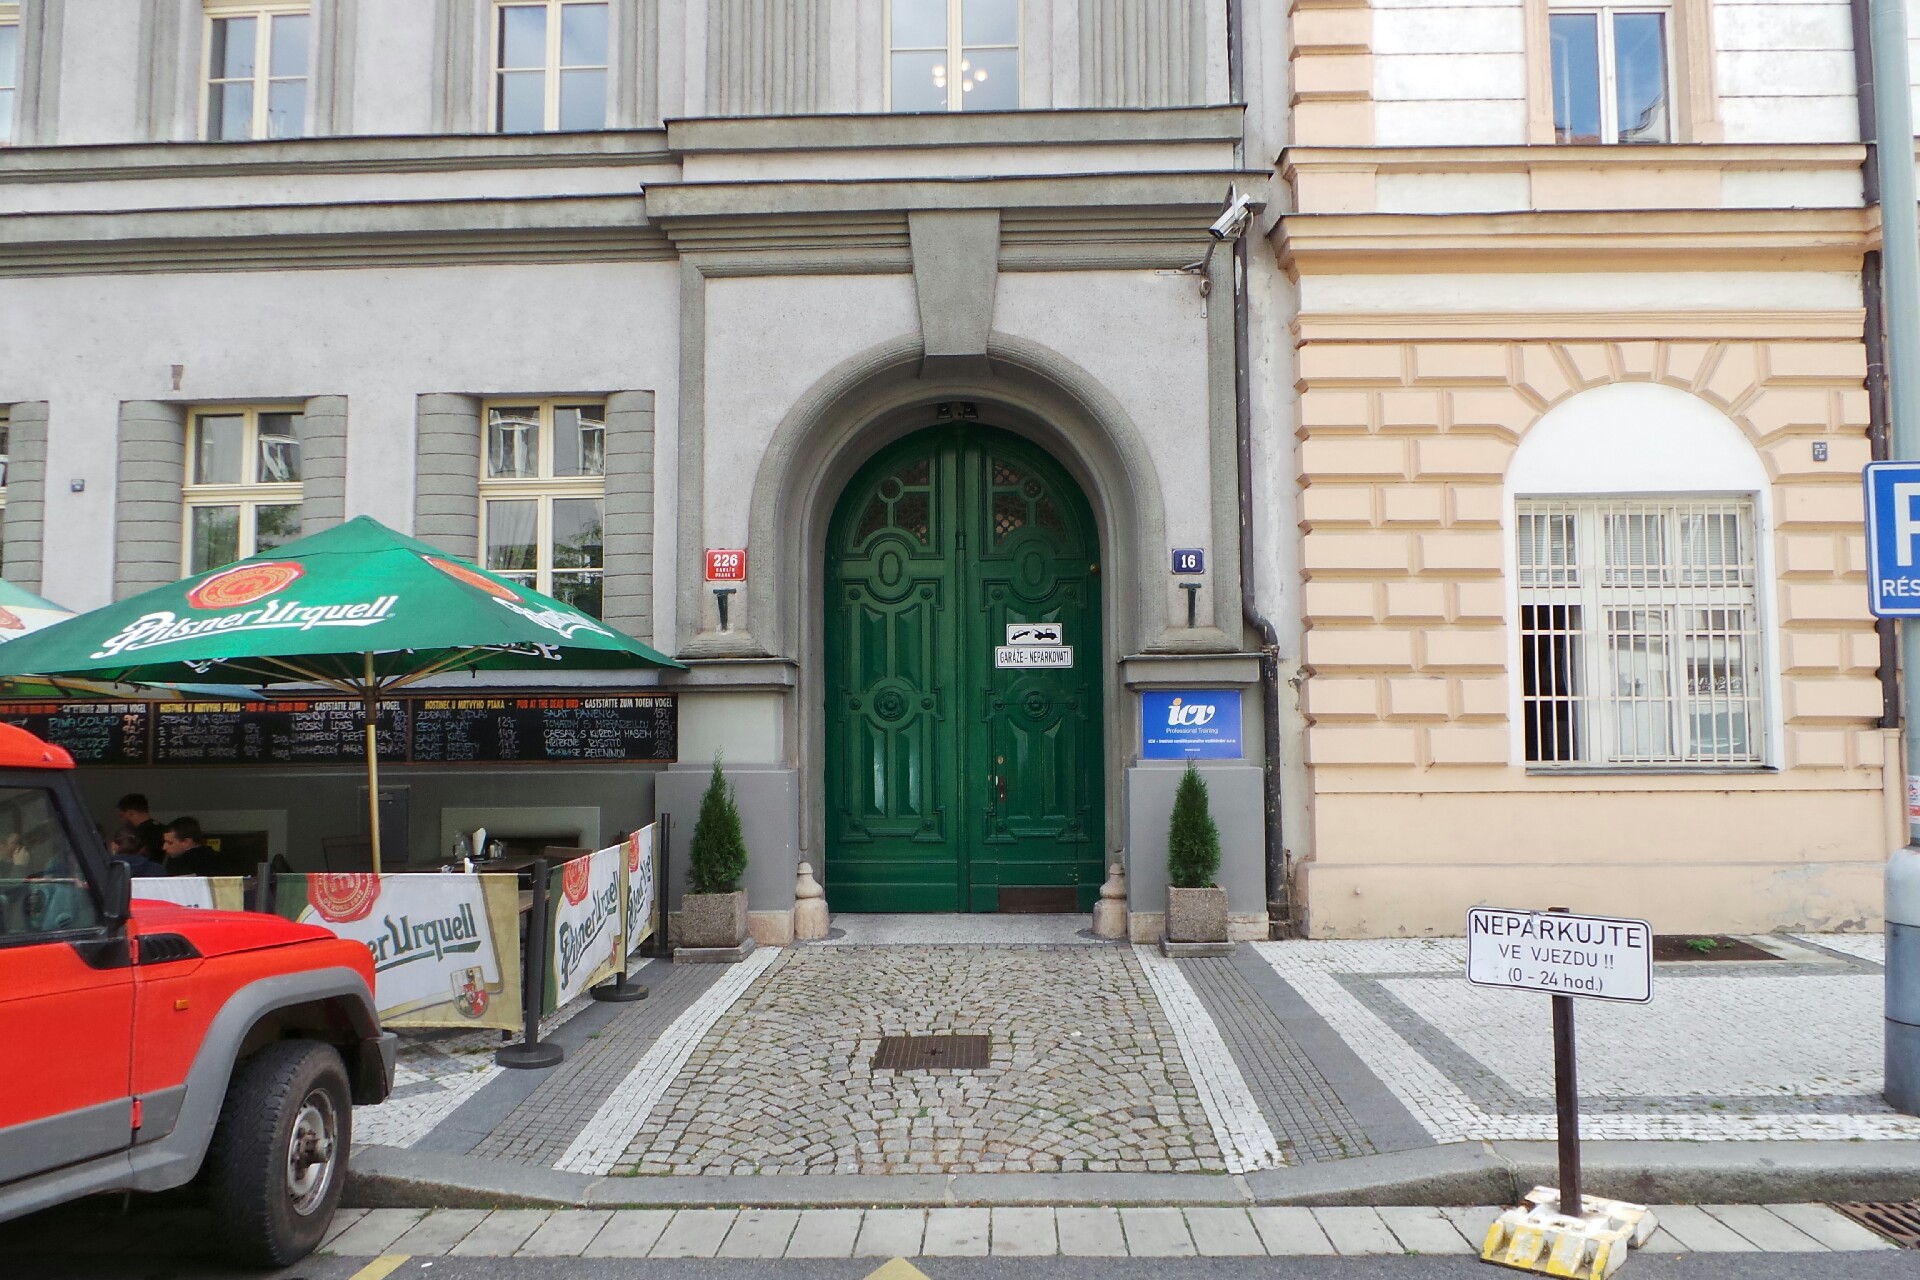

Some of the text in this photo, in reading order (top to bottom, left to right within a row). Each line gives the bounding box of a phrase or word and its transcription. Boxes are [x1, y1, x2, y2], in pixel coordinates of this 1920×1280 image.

[713, 554, 738, 568] 226
[1181, 554, 1196, 569] 16
[90, 596, 398, 659] Pilsner Urquell
[1000, 649, 1024, 663] GARÁŽE
[382, 701, 400, 710] VOGEL
[424, 700, 450, 710] HOSTINEC
[620, 698, 633, 708] ZUM
[635, 698, 653, 707] TOTEN
[655, 698, 672, 707] VOGEL
[384, 903, 478, 962] Urquell
[1474, 914, 1642, 948] NEPARKUJTE
[1498, 944, 1521, 960] VE
[1531, 946, 1598, 967] VJEZDU
[1508, 967, 1522, 983] (0
[1540, 971, 1558, 986] 24
[1564, 973, 1603, 992] hod.)
